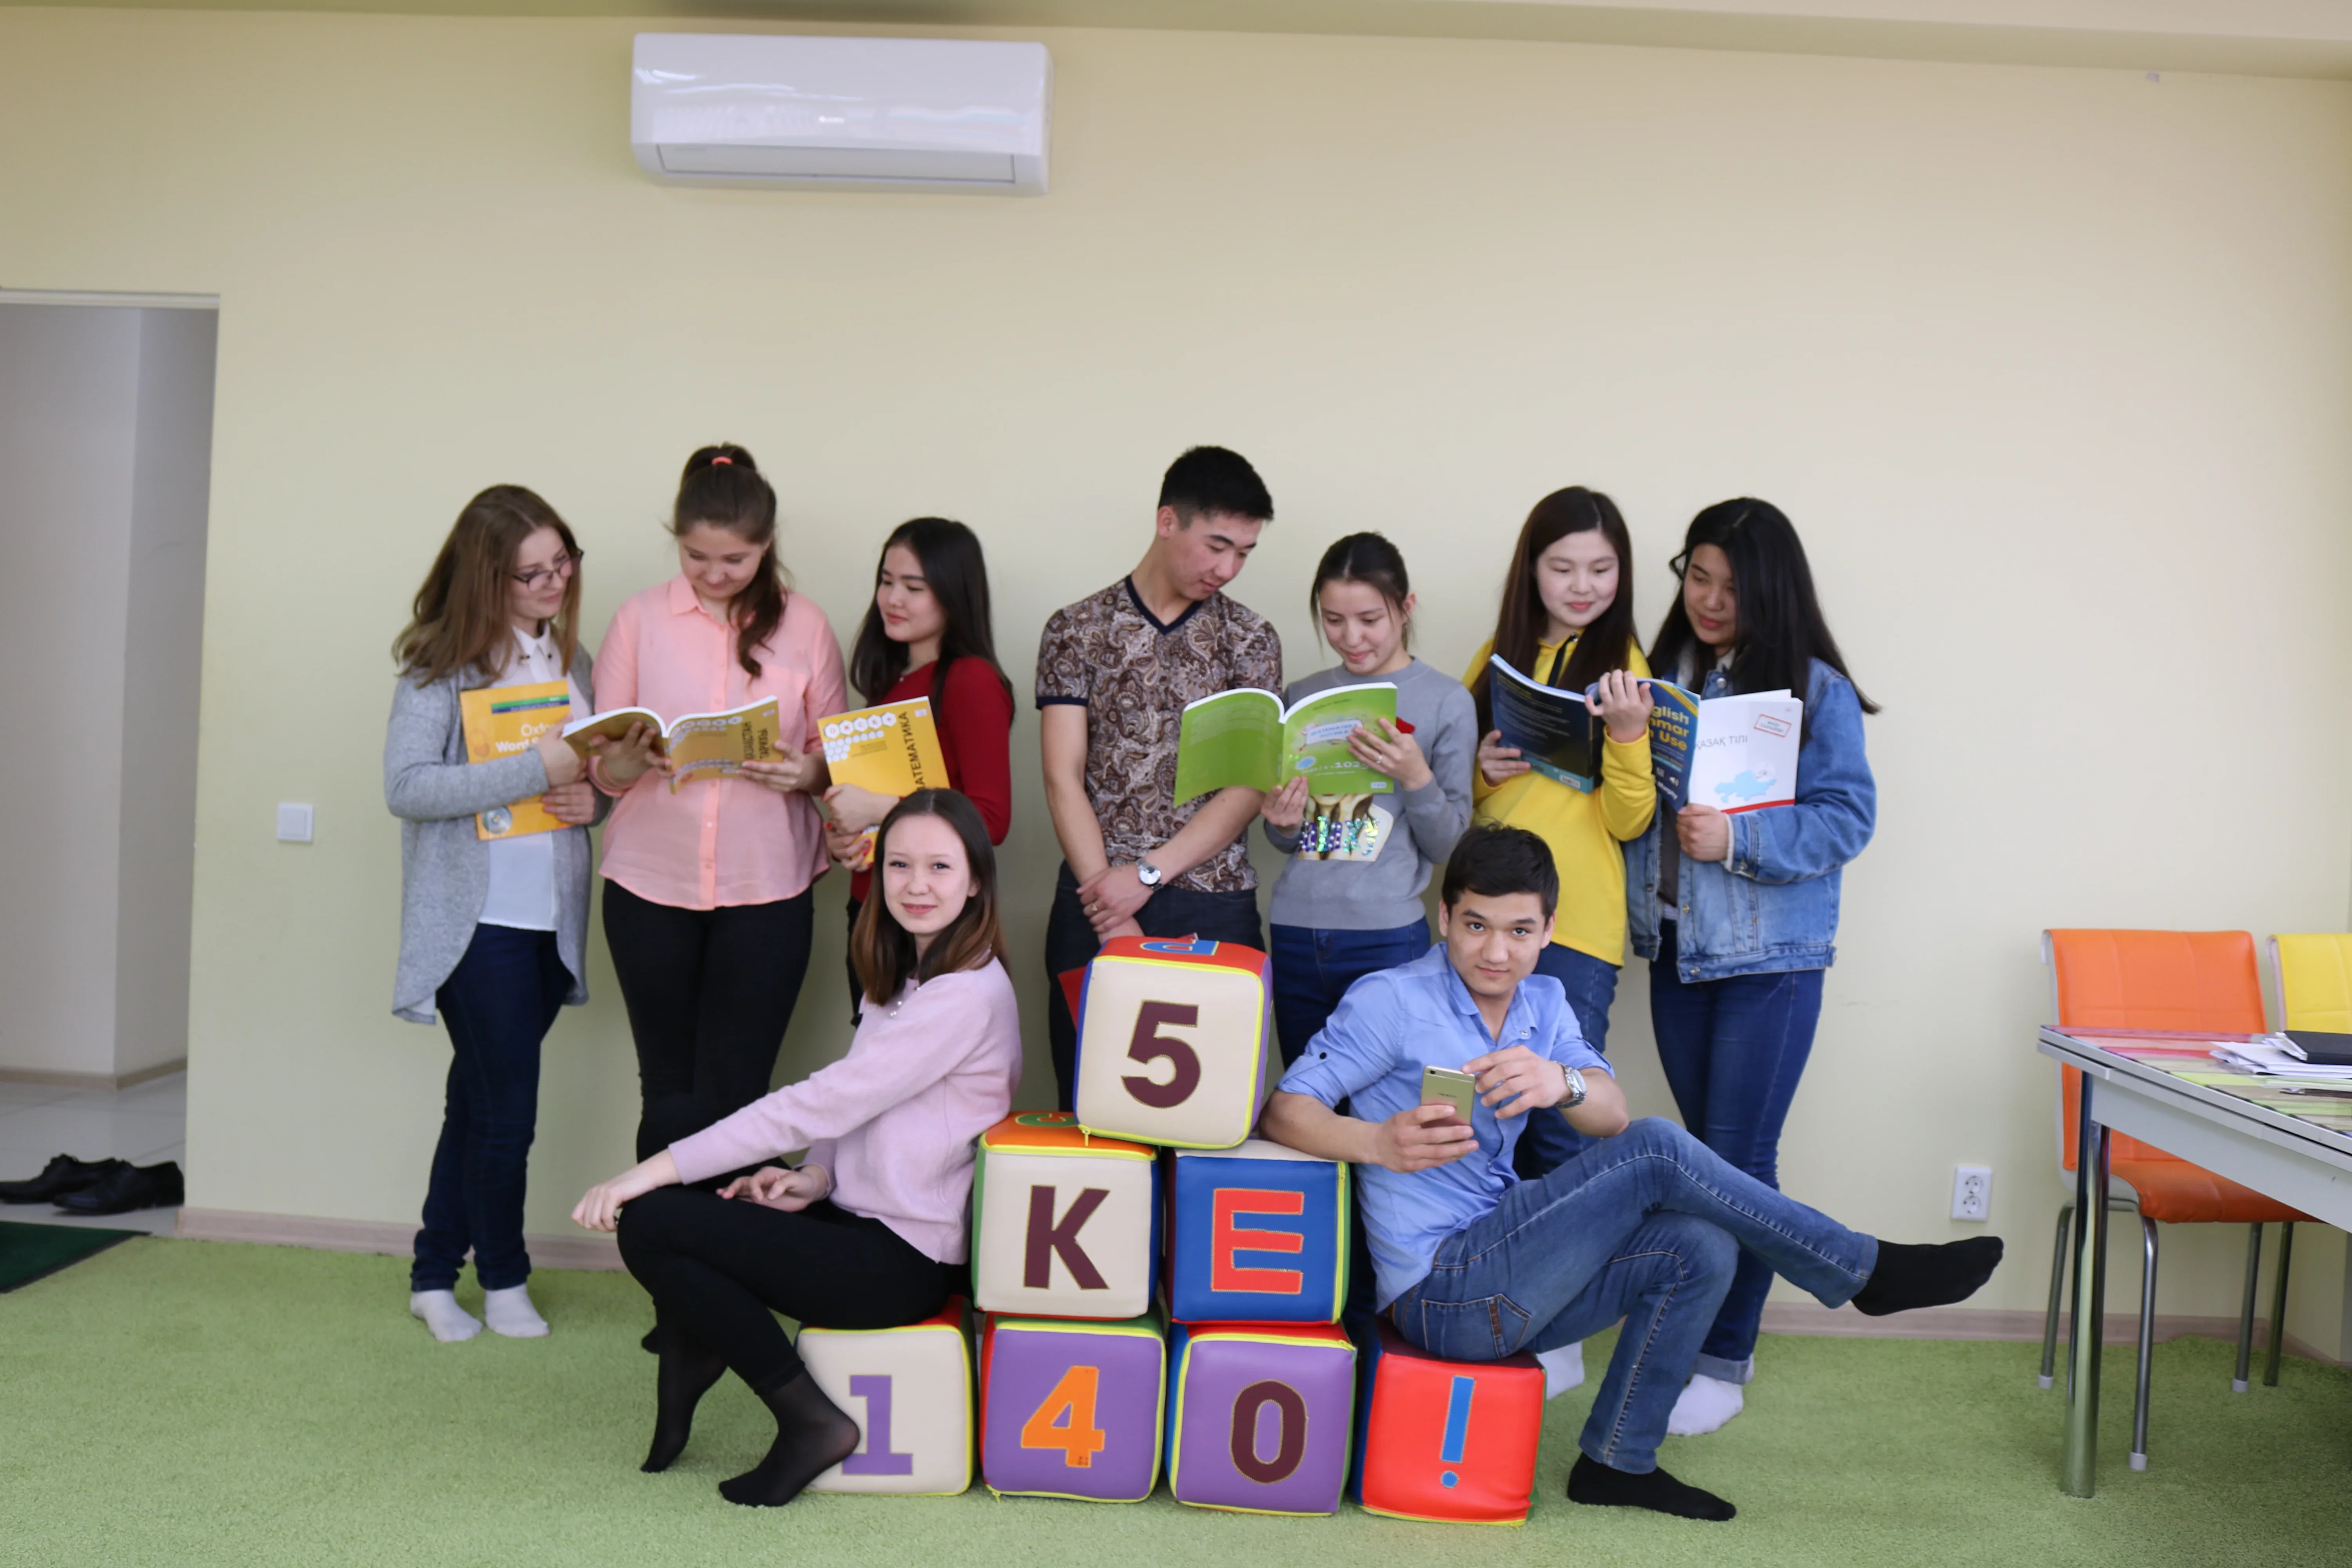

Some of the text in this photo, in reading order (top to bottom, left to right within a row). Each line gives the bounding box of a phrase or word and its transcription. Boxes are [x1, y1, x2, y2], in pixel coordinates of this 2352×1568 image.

[1651, 706, 1689, 725] glish
[1659, 730, 1687, 751] Use
[1120, 999, 1201, 1108] 5
